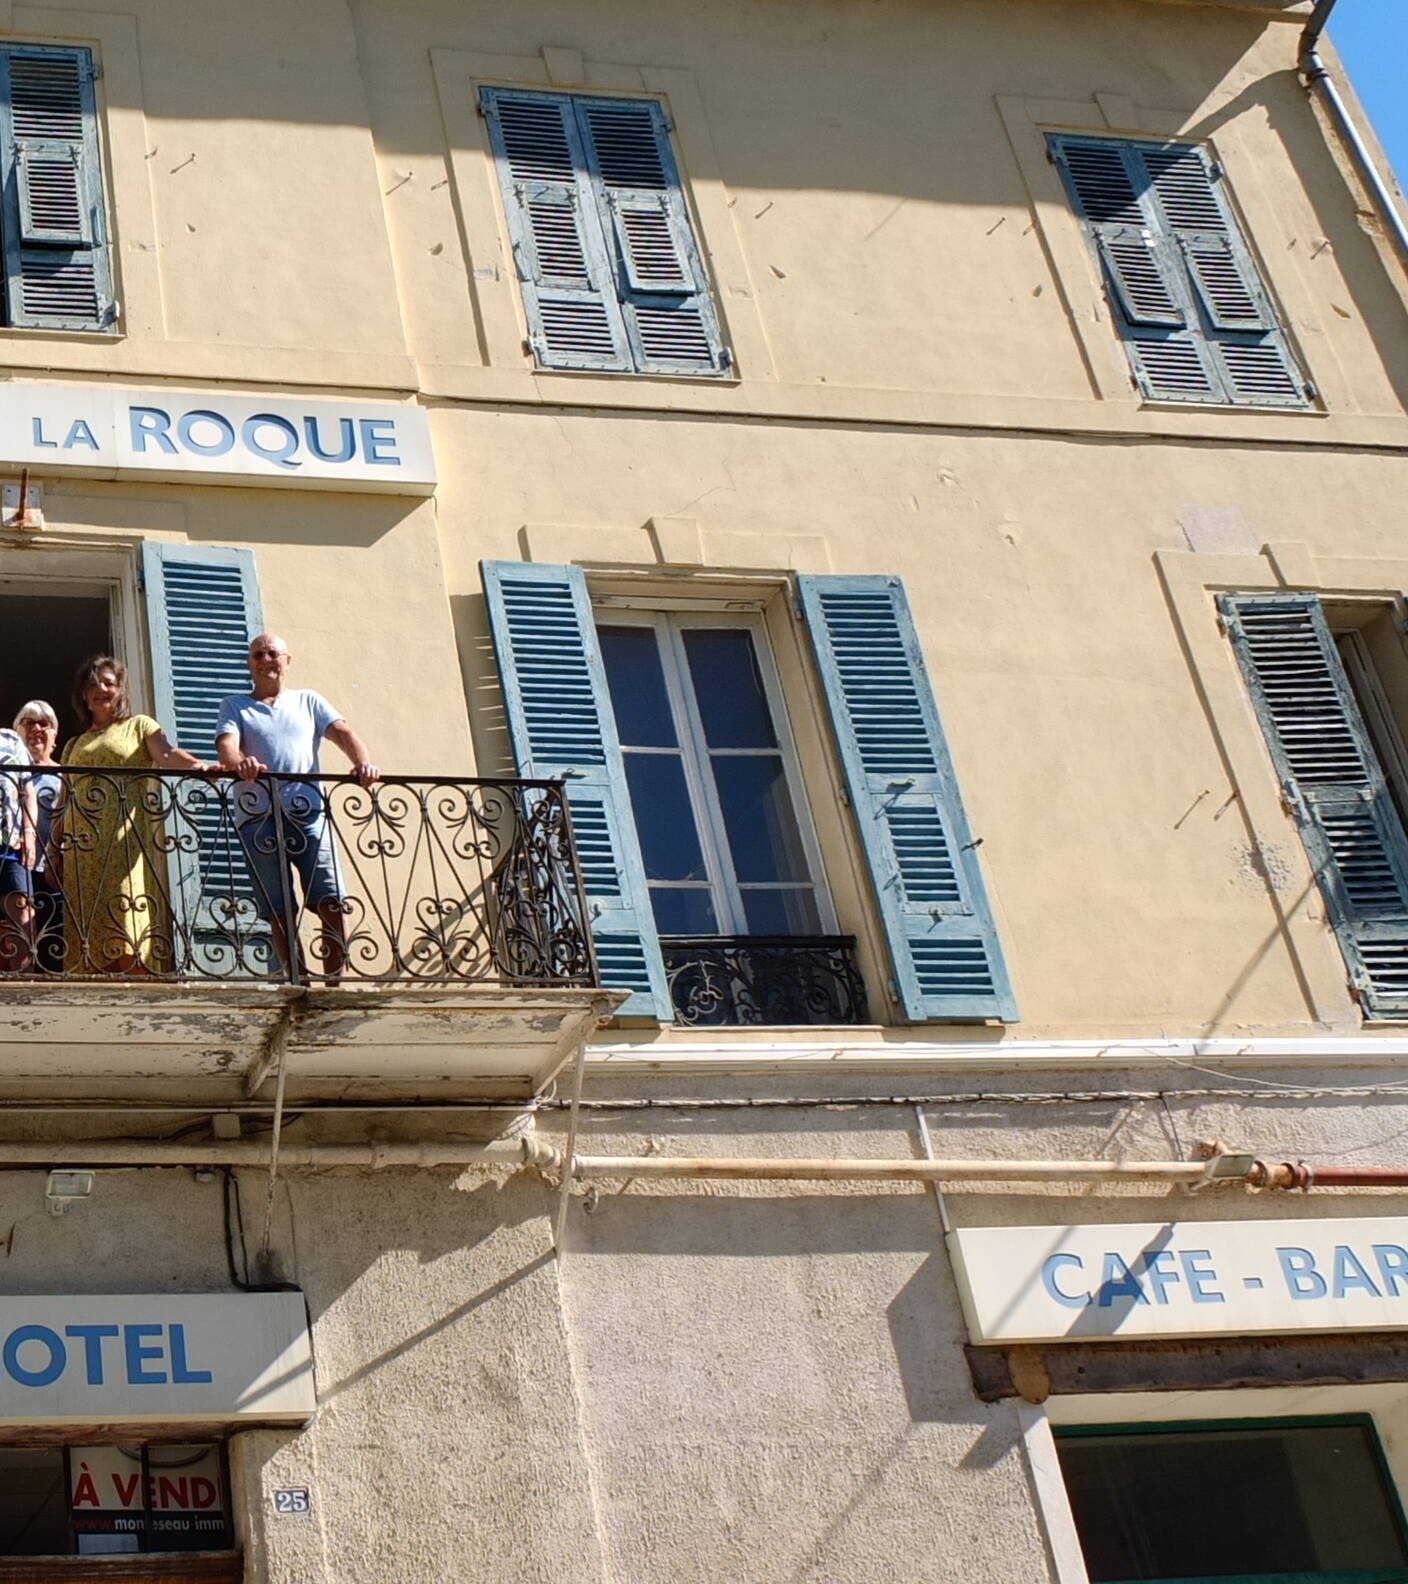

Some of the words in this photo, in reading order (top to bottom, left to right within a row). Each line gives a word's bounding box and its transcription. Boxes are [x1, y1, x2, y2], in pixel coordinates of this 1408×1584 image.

[32, 416, 100, 451] LA
[128, 405, 402, 470] ROQUE
[1041, 1250, 1226, 1308] CAFE
[1275, 1244, 1408, 1300] BAR
[72, 1461, 101, 1507] À
[111, 1473, 221, 1509] VEND
[277, 1491, 306, 1512] 25
